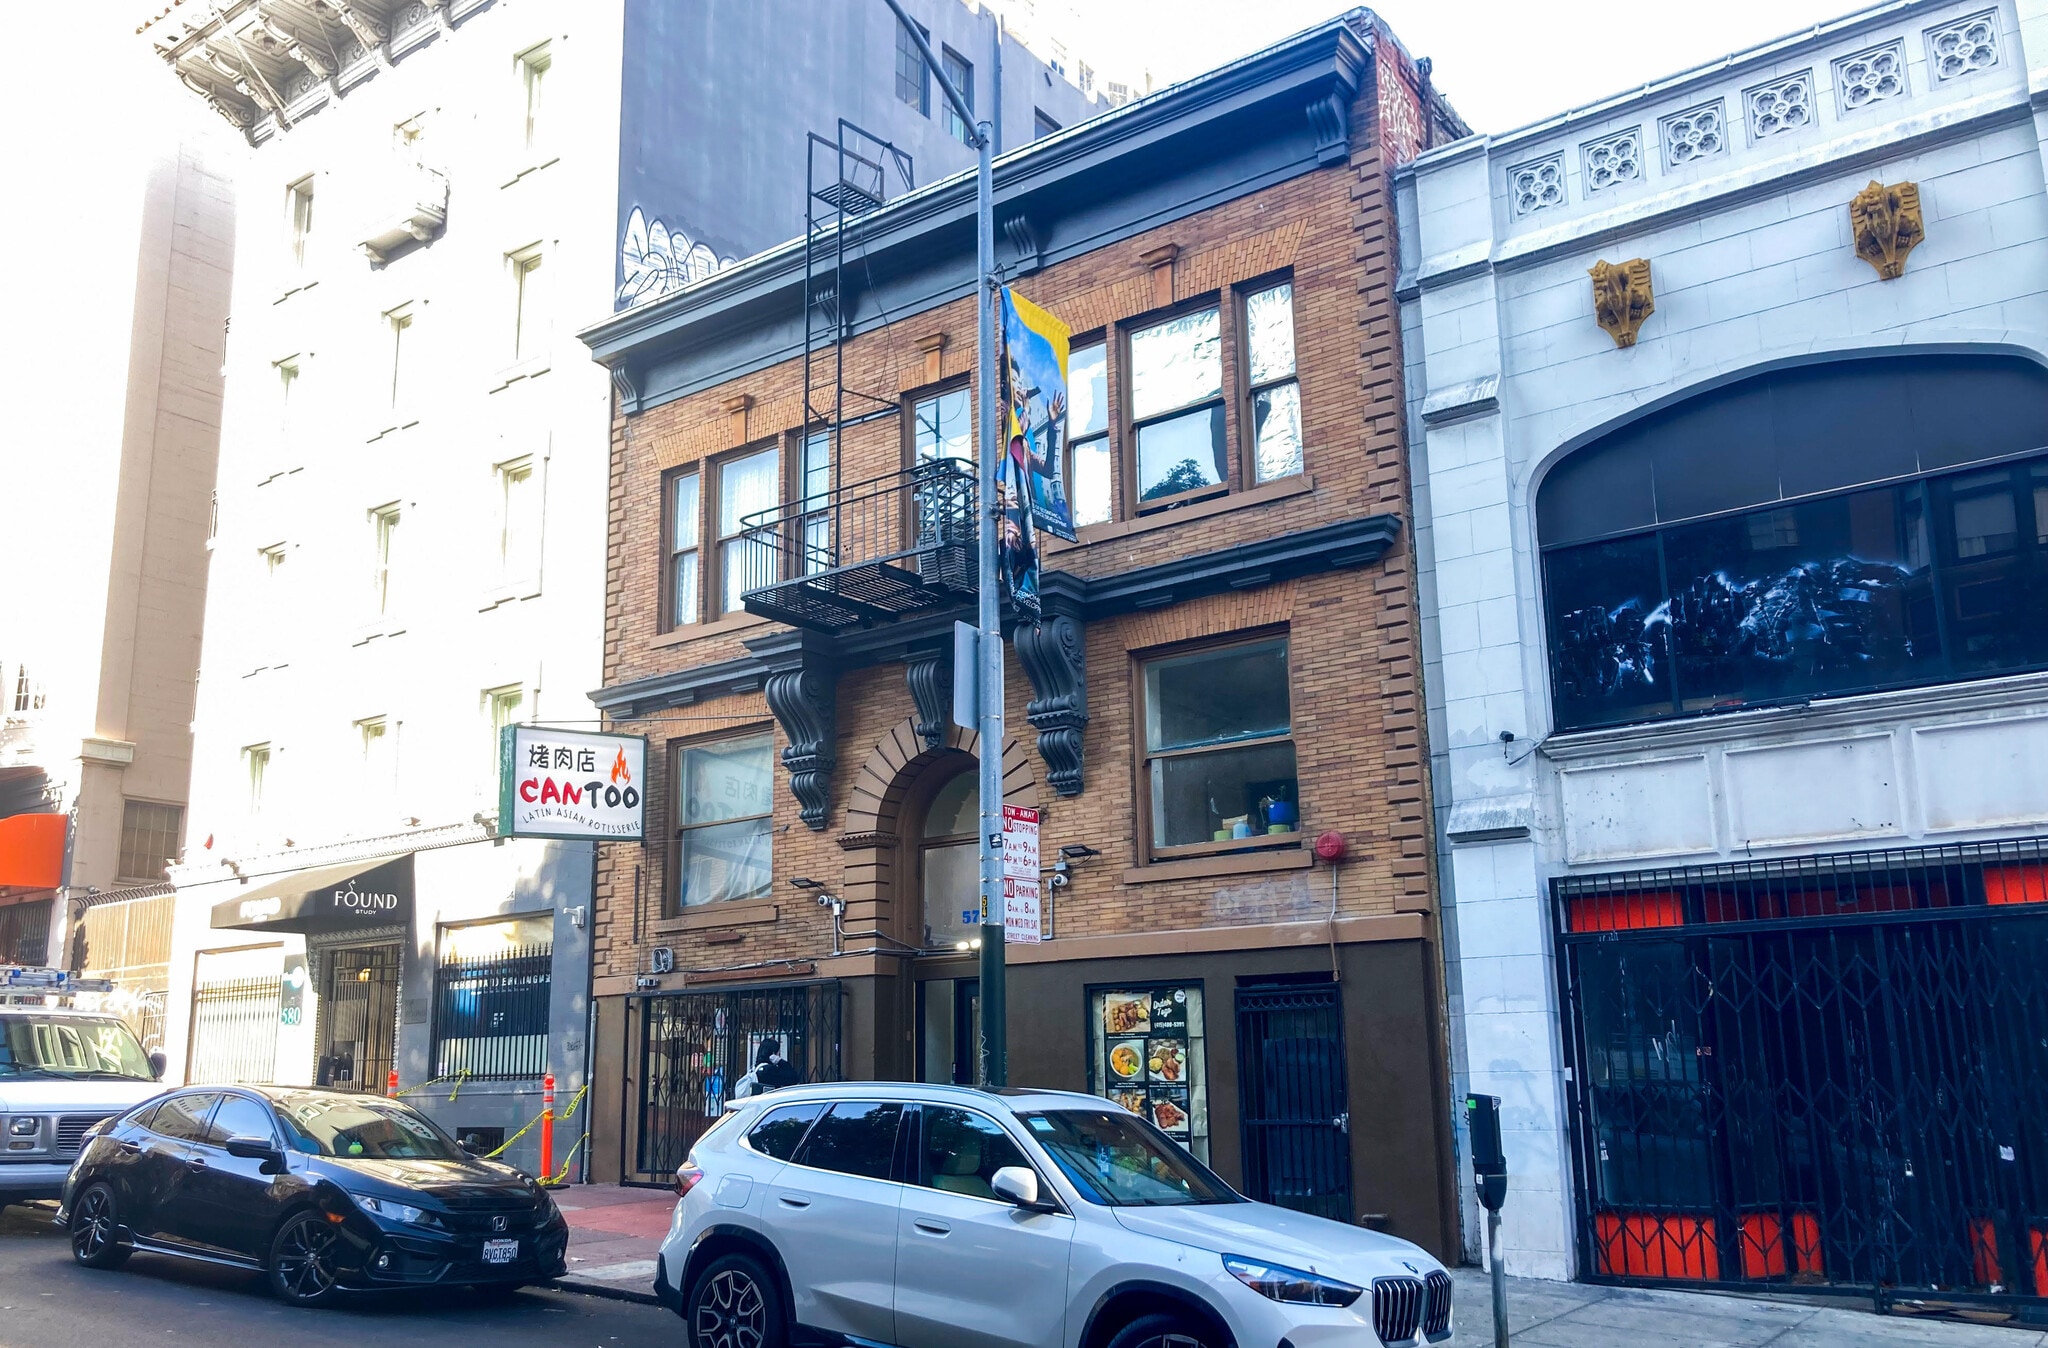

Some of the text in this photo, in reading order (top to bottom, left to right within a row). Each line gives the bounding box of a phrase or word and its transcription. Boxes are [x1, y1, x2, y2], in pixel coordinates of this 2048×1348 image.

[529, 743, 596, 773] 烤肉店
[519, 776, 640, 809] CANTOO
[522, 807, 641, 834] LATIN ASIAN ROTISSERIE
[1003, 816, 1038, 836] NO STOPPING
[1003, 878, 1038, 899] NO PARKING
[334, 889, 398, 910] FOUND
[1006, 932, 1039, 942] STREET CLEANING
[281, 1007, 301, 1025] 580
